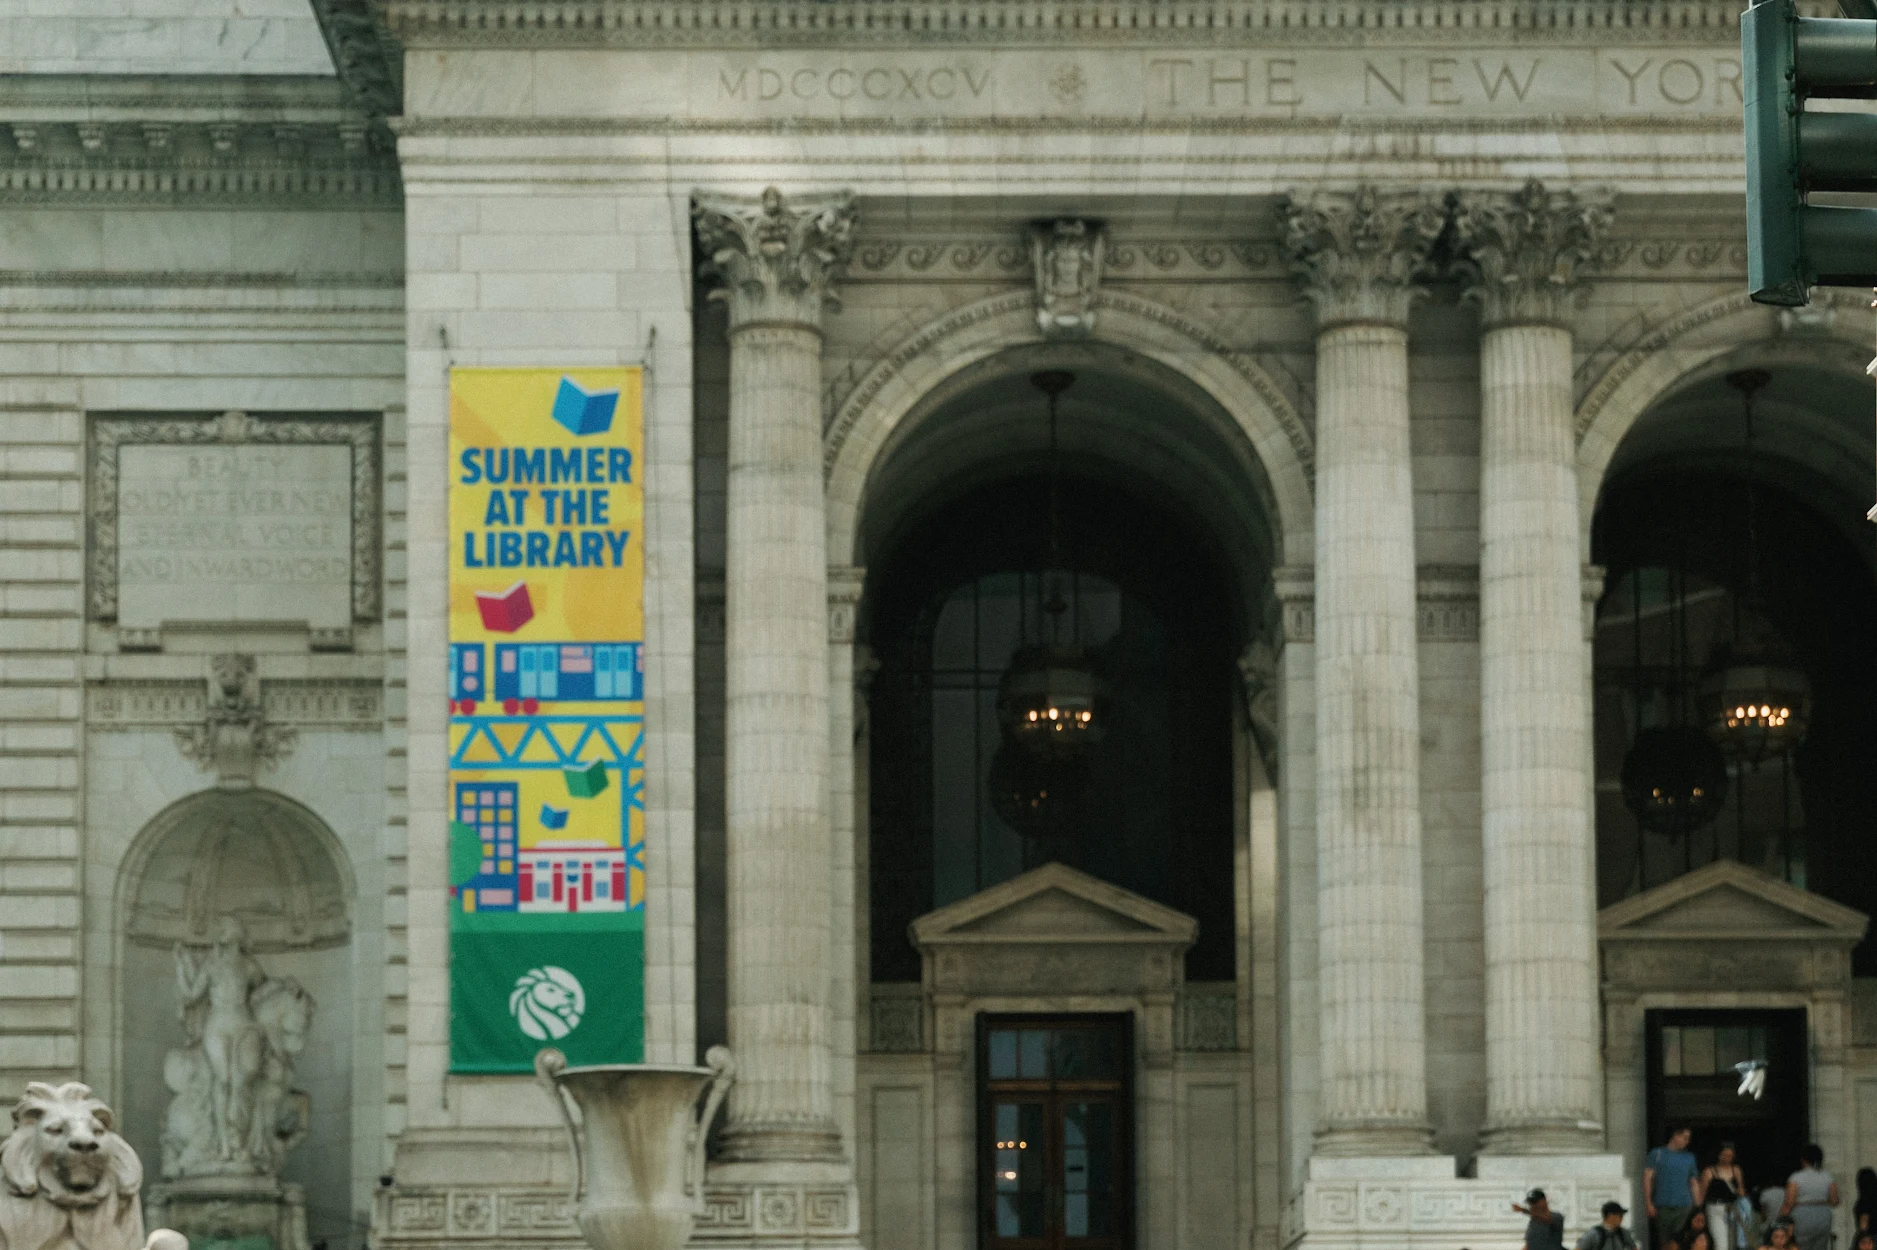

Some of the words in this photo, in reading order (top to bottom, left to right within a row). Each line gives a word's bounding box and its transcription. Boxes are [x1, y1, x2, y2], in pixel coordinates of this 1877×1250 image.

[717, 67, 991, 101] MDCCCXCV
[1150, 58, 1302, 107] THE
[1363, 58, 1541, 106] NEW
[460, 447, 632, 485] SUMMER
[484, 489, 530, 526] AT
[540, 489, 610, 526] THE
[464, 531, 631, 568] LIBRARY
